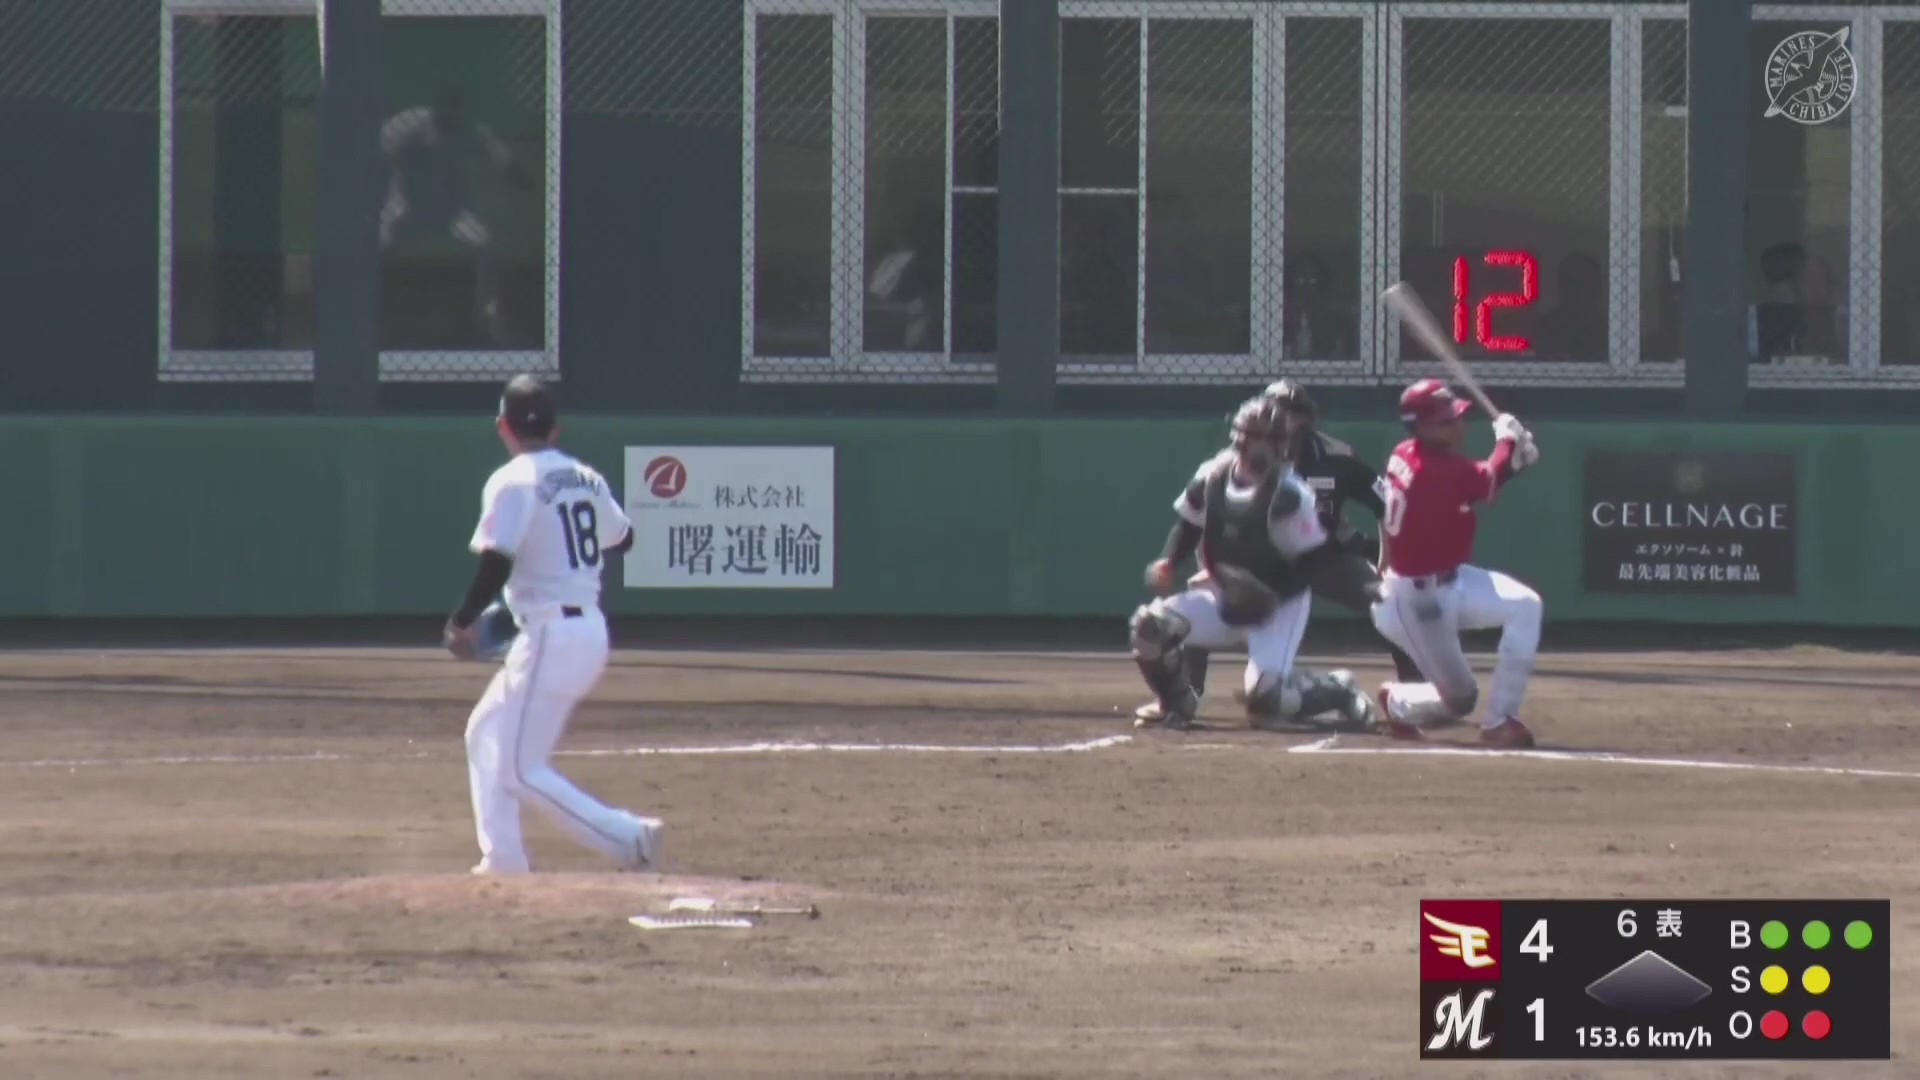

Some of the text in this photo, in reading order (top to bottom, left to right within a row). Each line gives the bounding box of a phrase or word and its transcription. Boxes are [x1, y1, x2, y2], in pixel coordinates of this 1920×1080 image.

[1454, 250, 1539, 351] 12
[714, 484, 804, 508] 株式会社
[1592, 502, 1788, 529] CELLNAGE
[557, 500, 601, 570] 18
[668, 523, 822, 576] 曙運輸
[1618, 563, 1760, 582] 最先端美容化粧品
